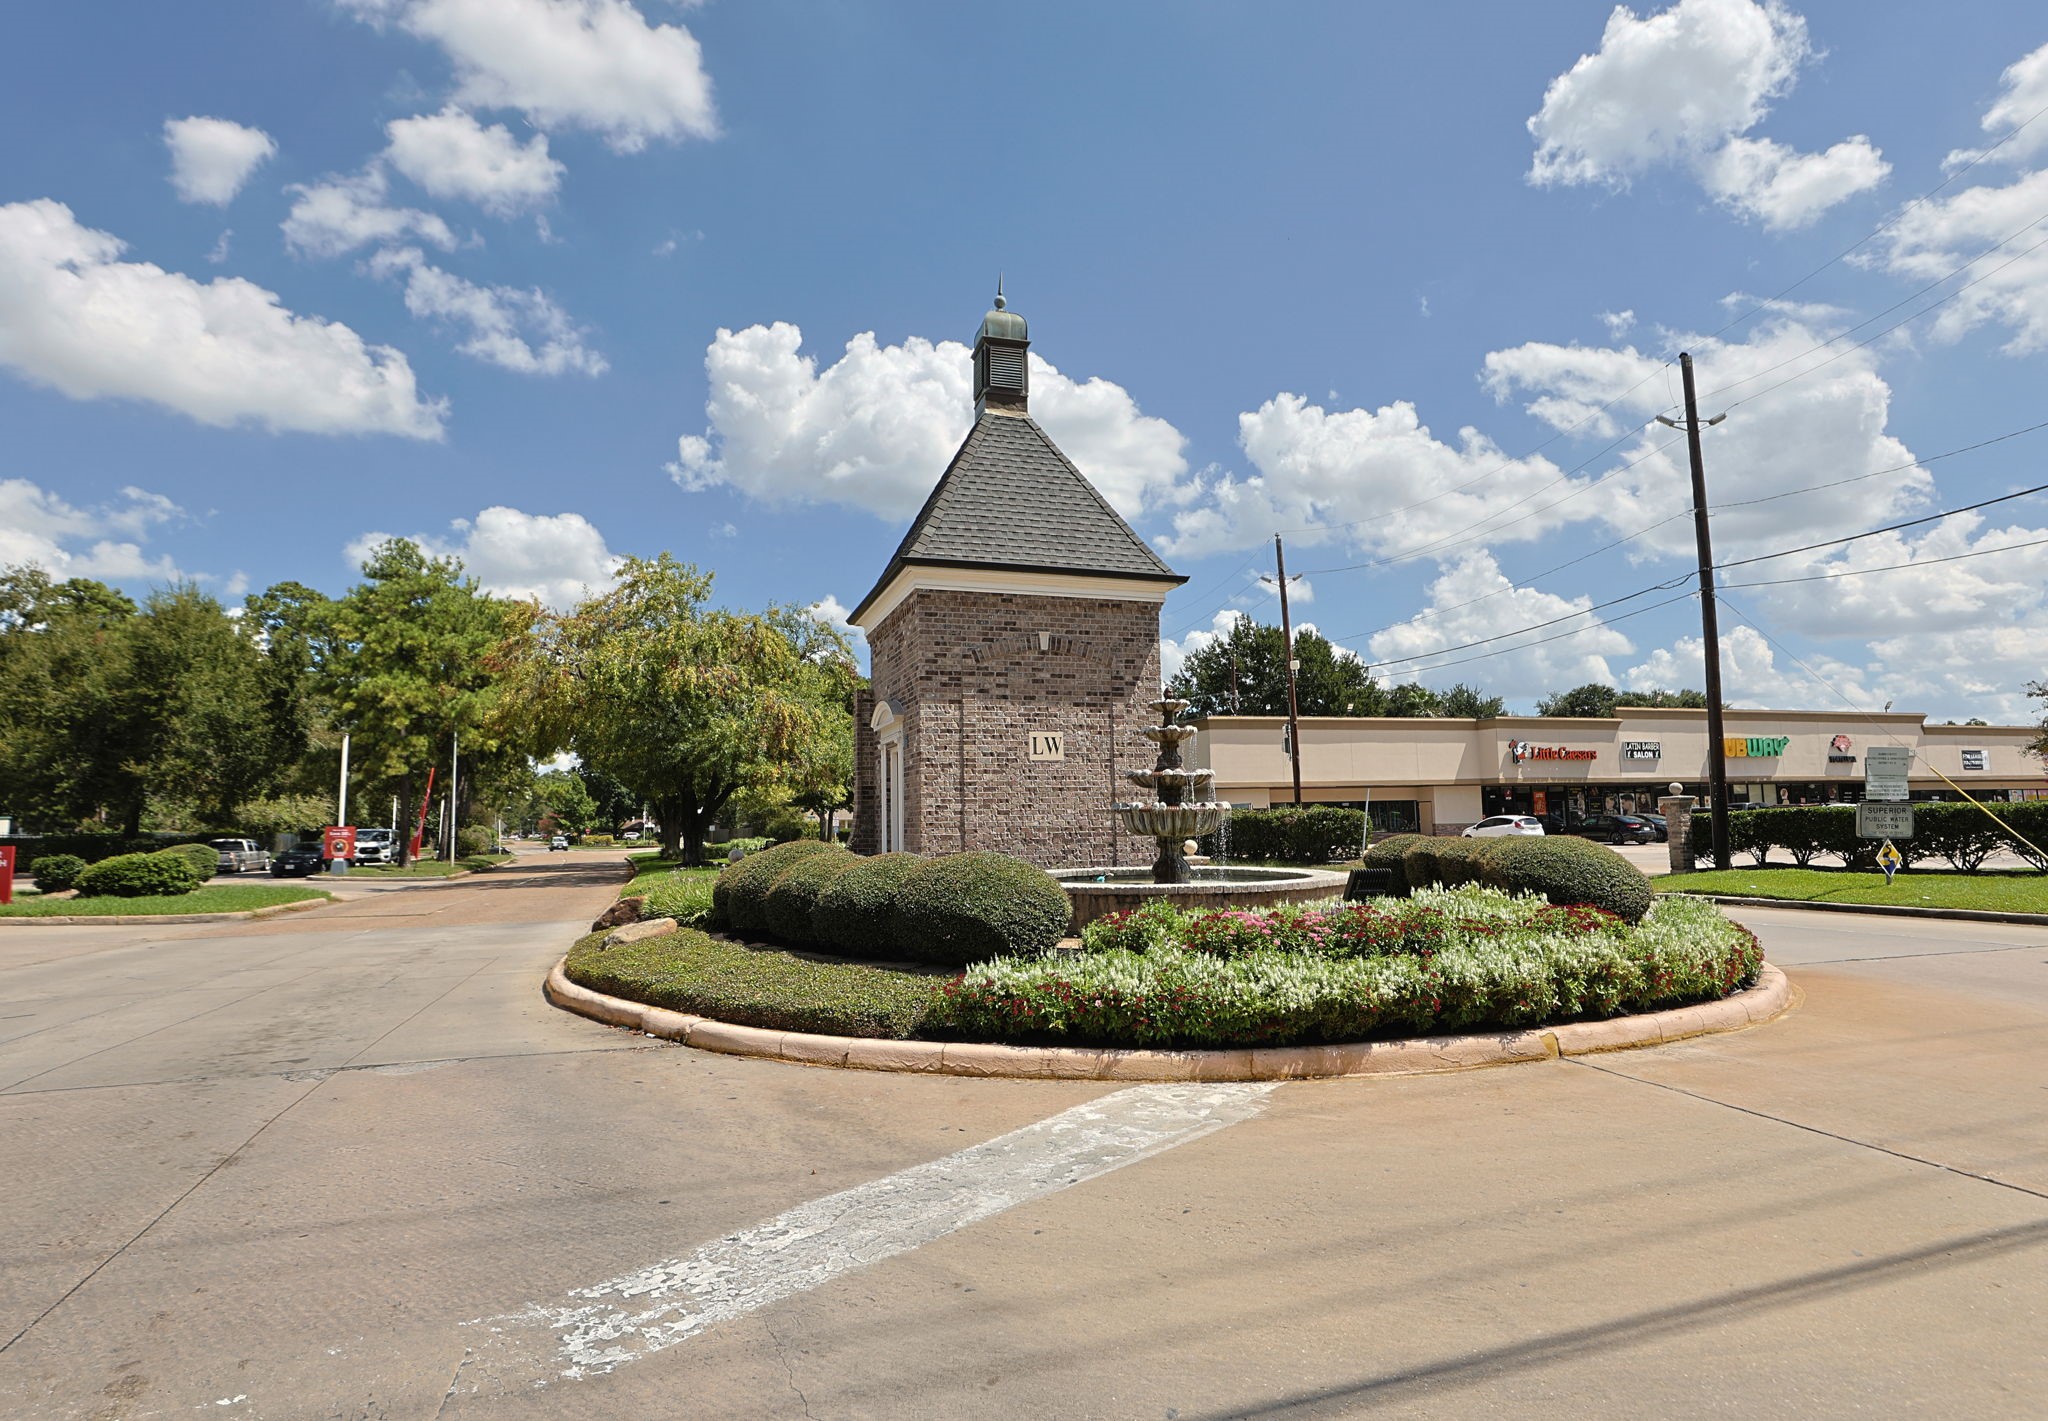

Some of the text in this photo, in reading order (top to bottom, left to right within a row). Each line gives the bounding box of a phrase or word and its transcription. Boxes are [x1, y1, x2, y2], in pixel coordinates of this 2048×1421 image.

[1031, 736, 1063, 756] LW
[1625, 742, 1660, 751] LATIN BARBER
[1724, 736, 1790, 758] UBWAY
[1530, 746, 1597, 761] Little Caesars
[1633, 750, 1653, 759] SALON
[1867, 806, 1907, 815] SUPERIOR
[1865, 815, 1888, 823] PUBLIC
